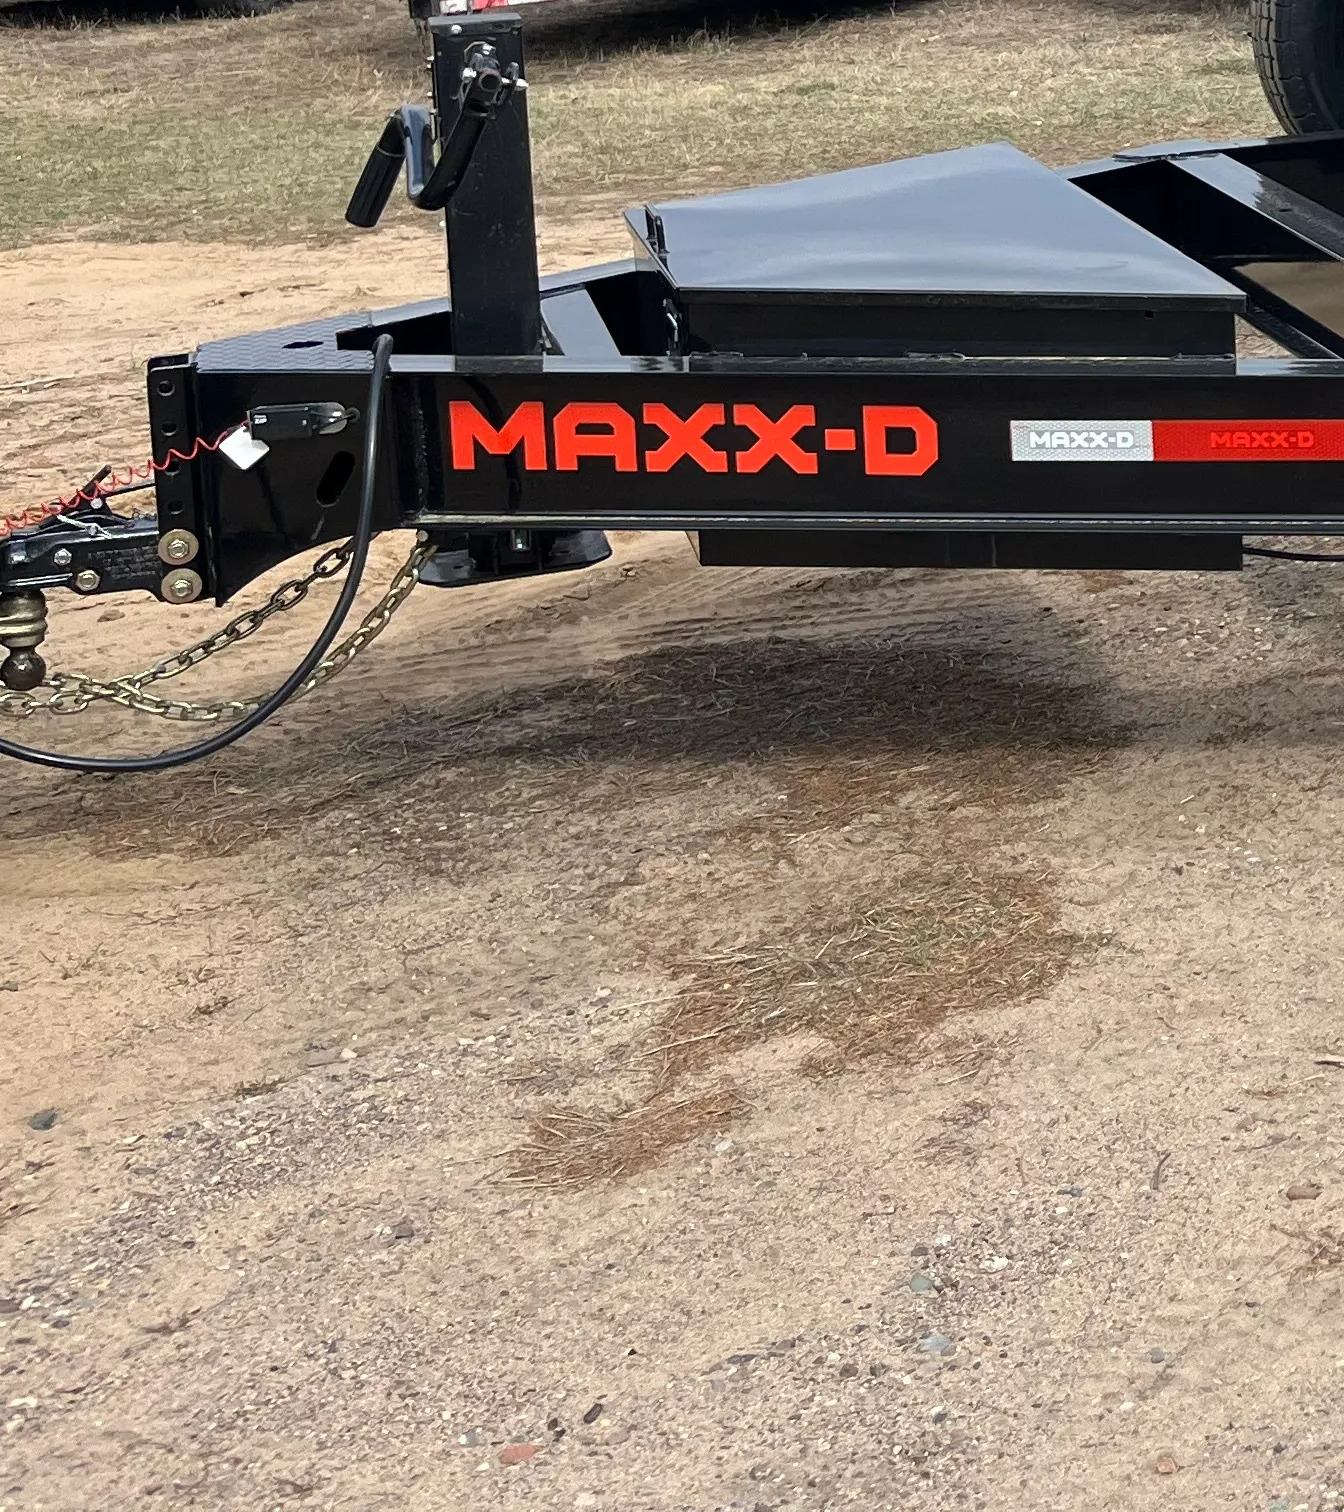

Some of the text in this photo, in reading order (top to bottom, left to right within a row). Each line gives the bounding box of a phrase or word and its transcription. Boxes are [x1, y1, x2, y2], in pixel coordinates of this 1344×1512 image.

[449, 401, 938, 475] MAXX-D
[1030, 431, 1314, 448] MAXX-D MAXX-D
